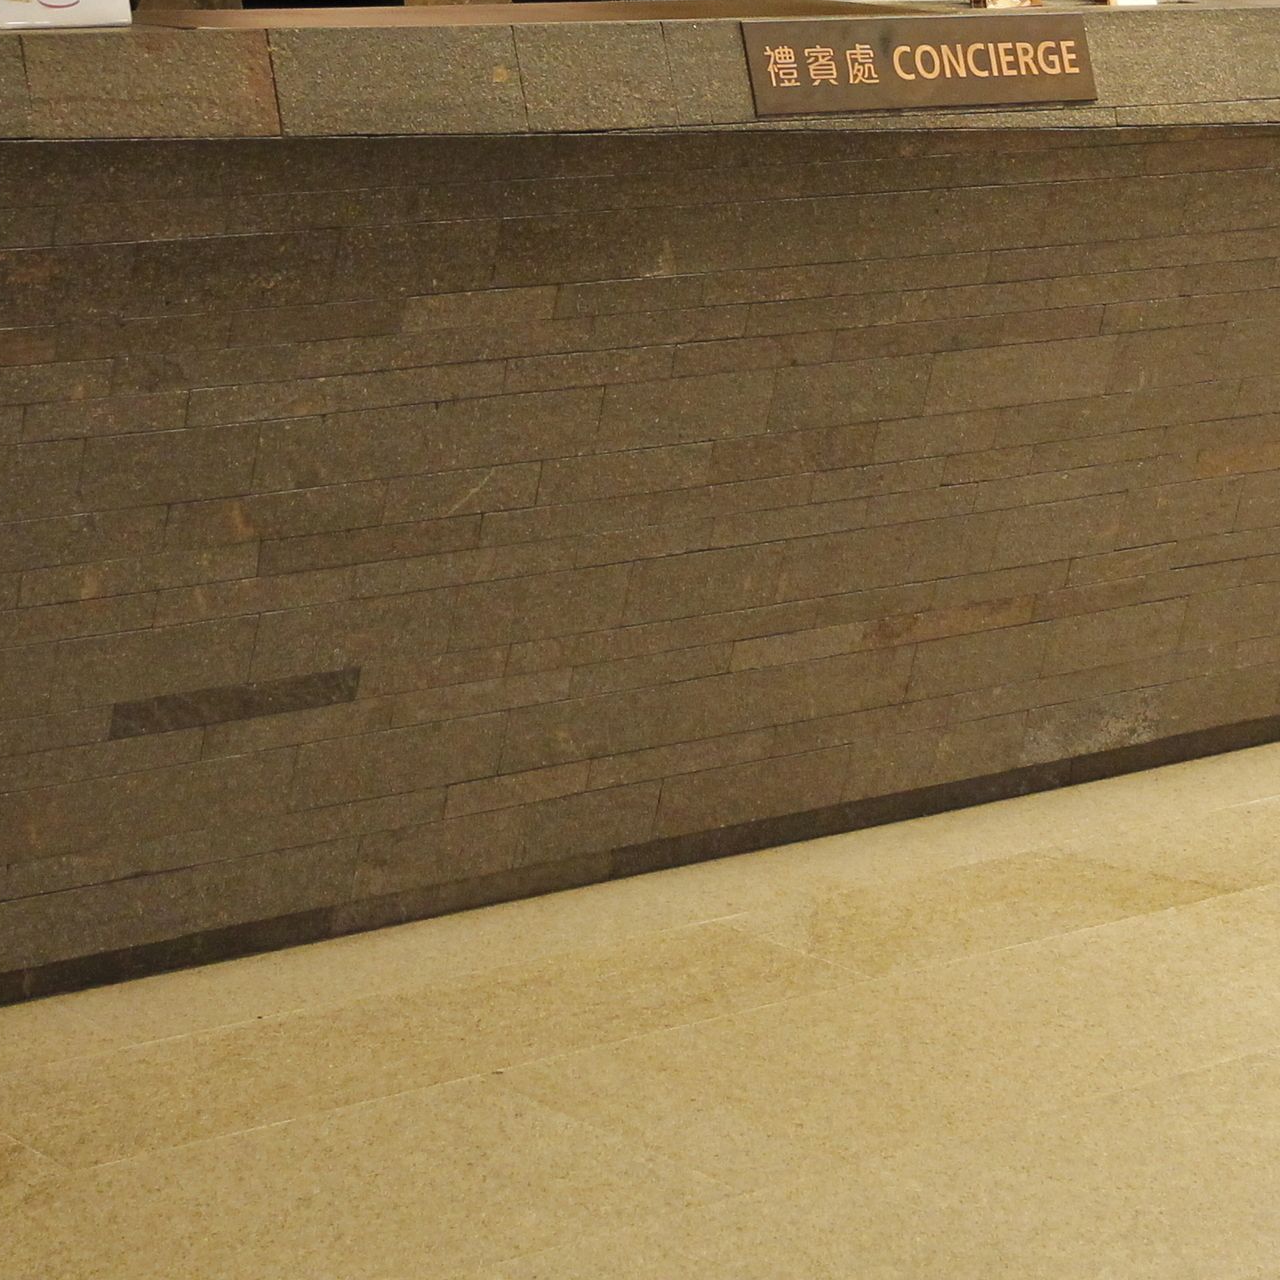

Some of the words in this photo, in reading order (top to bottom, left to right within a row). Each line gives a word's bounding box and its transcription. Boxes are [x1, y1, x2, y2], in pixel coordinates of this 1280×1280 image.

[763, 43, 880, 88] 禮賓處
[892, 40, 1081, 81] CONCIERGE
